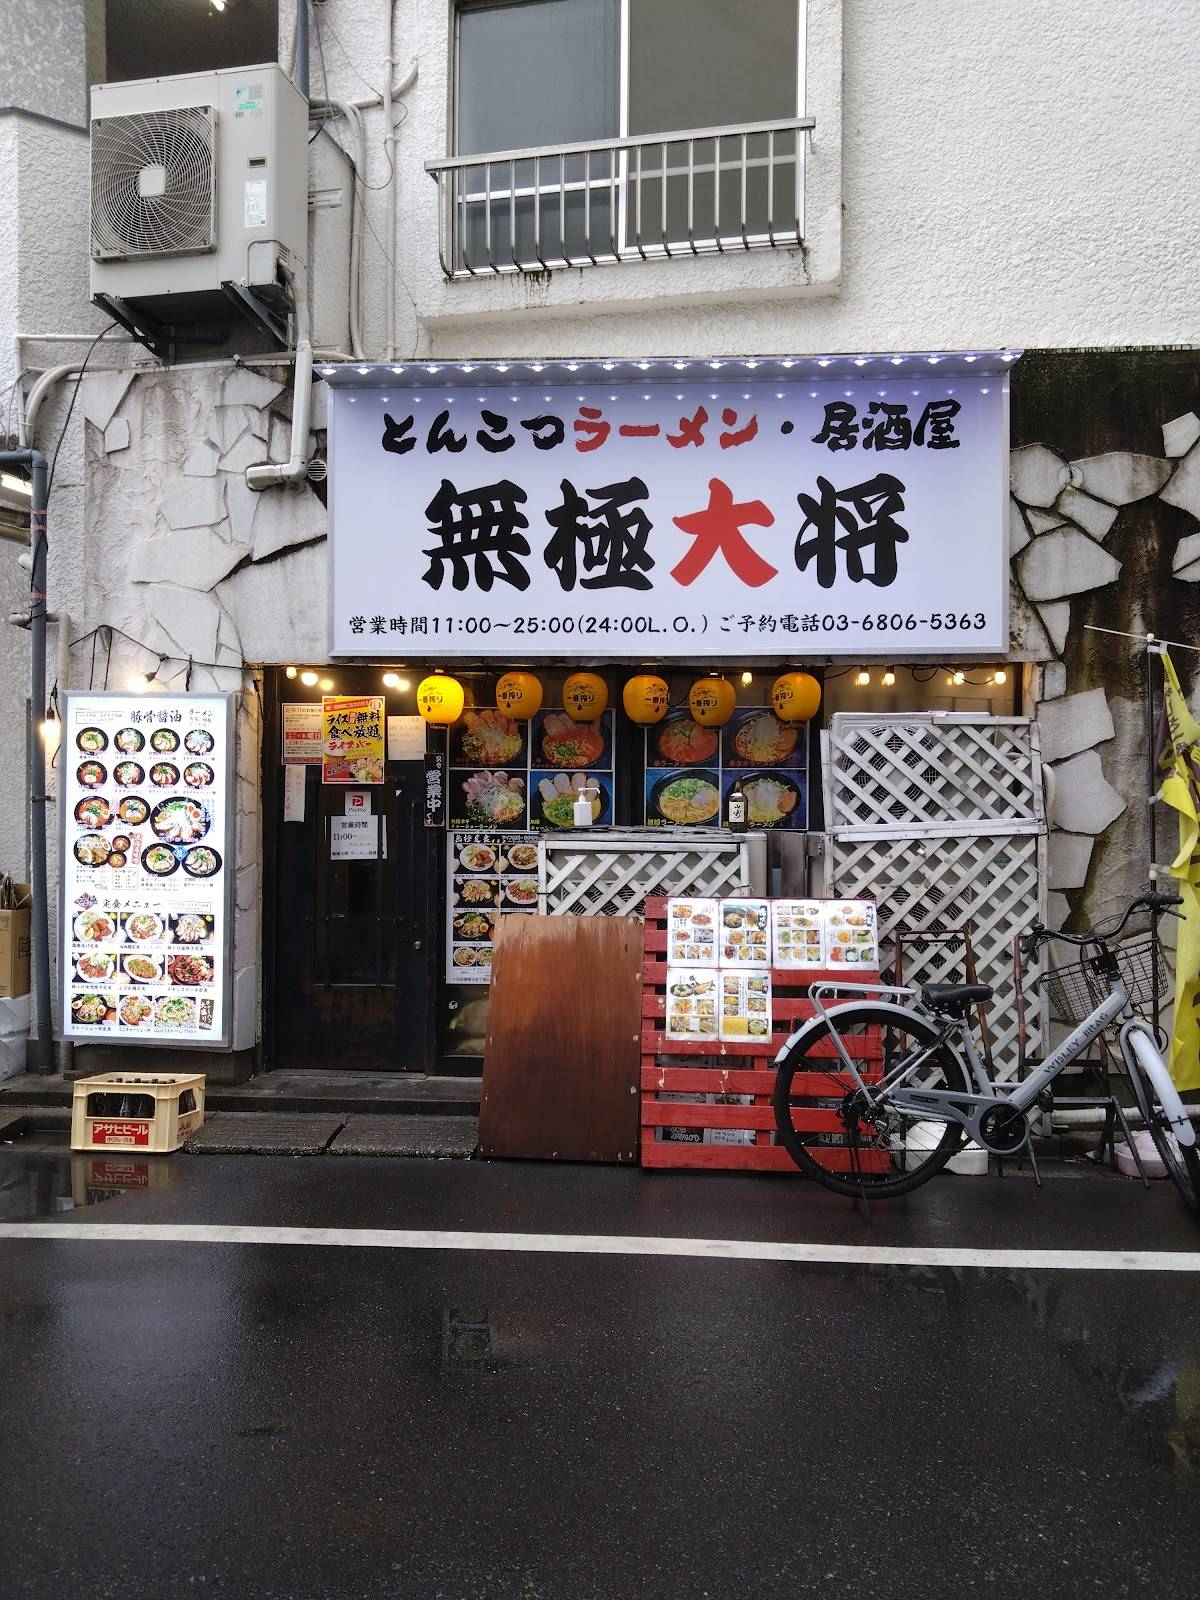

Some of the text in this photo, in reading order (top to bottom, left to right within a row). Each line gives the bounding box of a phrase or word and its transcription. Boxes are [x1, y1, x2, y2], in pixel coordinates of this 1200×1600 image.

[381, 399, 961, 453] とんこつラーメン・居酒屋
[420, 473, 910, 591] 無極大将
[719, 612, 986, 634] ご予約電話03-6806-5363
[130, 710, 182, 723] 豚骨醤油
[103, 899, 161, 909] 定食メニュー
[94, 1124, 148, 1135] アサヒビール
